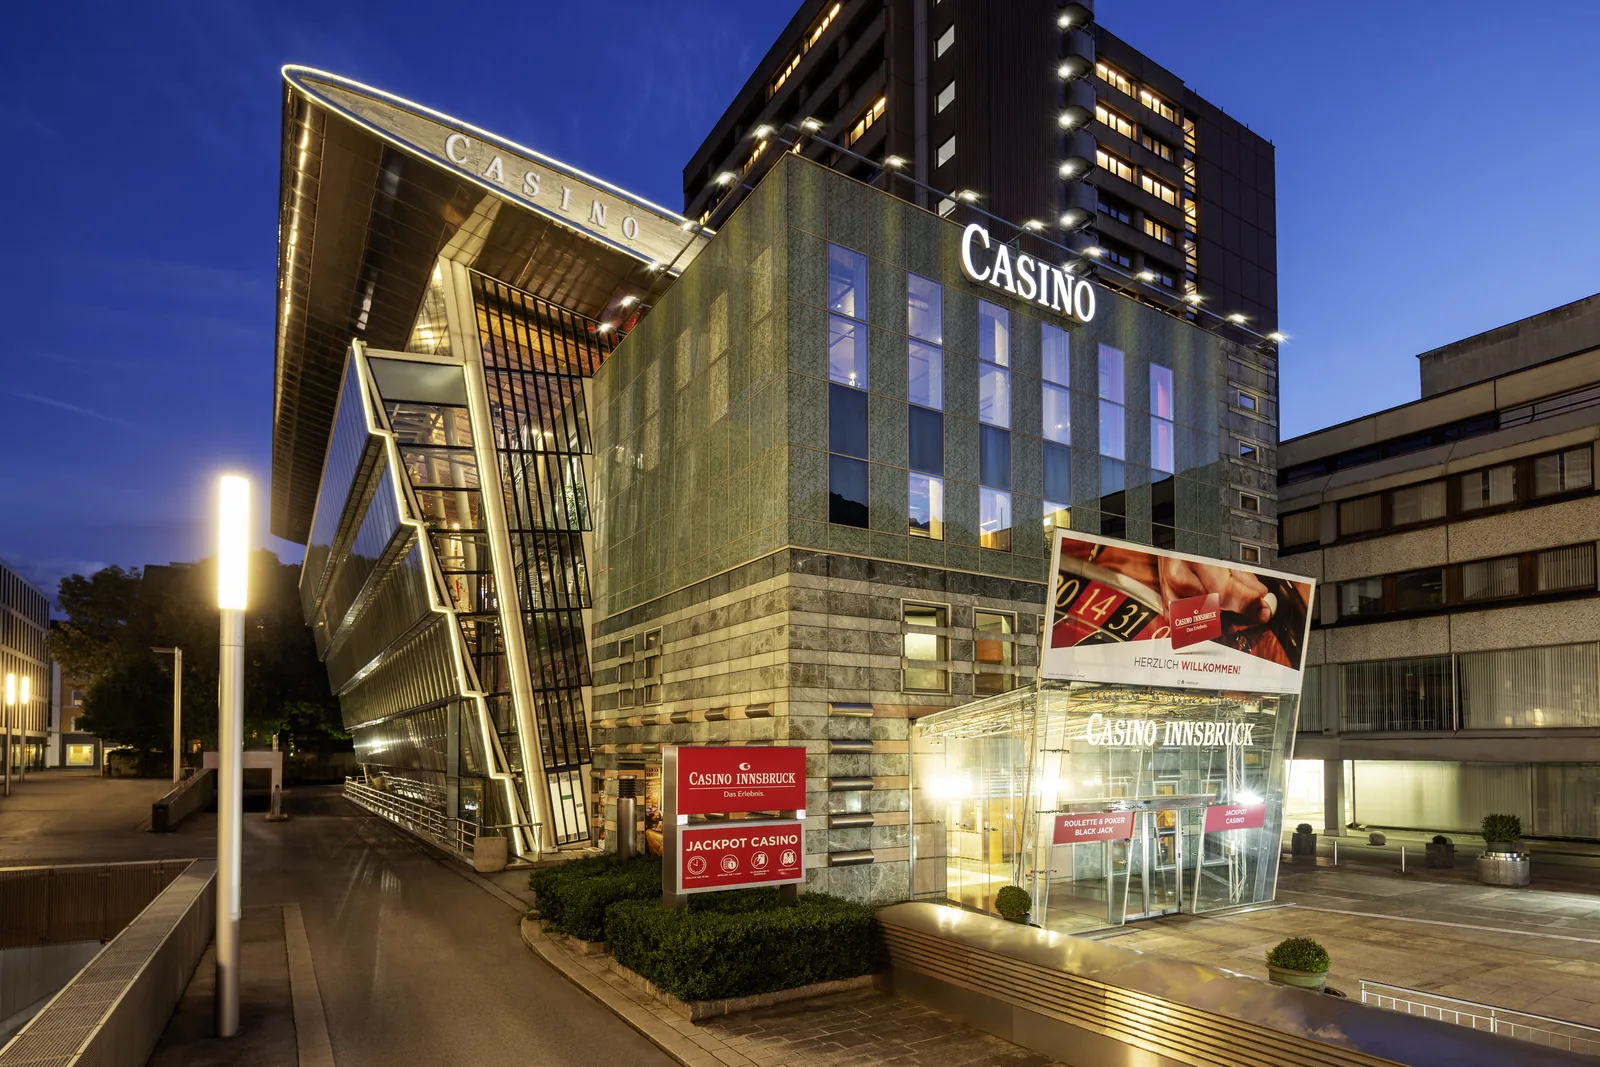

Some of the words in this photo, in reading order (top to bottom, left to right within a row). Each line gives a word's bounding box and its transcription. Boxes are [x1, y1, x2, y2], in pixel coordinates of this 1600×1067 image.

[445, 133, 639, 240] CASINO
[961, 223, 1096, 322] CASINO
[1076, 588, 1117, 621] 14
[1108, 604, 1150, 638] 31
[1175, 616, 1193, 627] CASINO
[1134, 656, 1179, 670] HERZLICH
[1181, 660, 1241, 675] WILLKOMMEN!
[1087, 713, 1157, 746] CASINO
[1163, 721, 1255, 746] INNSBRUCK
[689, 772, 732, 786] CASINO
[736, 772, 796, 785] INNSBRUCK
[1064, 818, 1098, 827] ROULETTE
[1105, 817, 1126, 825] POKER
[1224, 809, 1247, 817] JACKPOT
[1225, 817, 1245, 825] CASINO
[1074, 827, 1095, 836] BLACK
[1096, 826, 1114, 835] JACK
[686, 838, 748, 852] JACKPOT
[751, 834, 799, 847] CASINO
